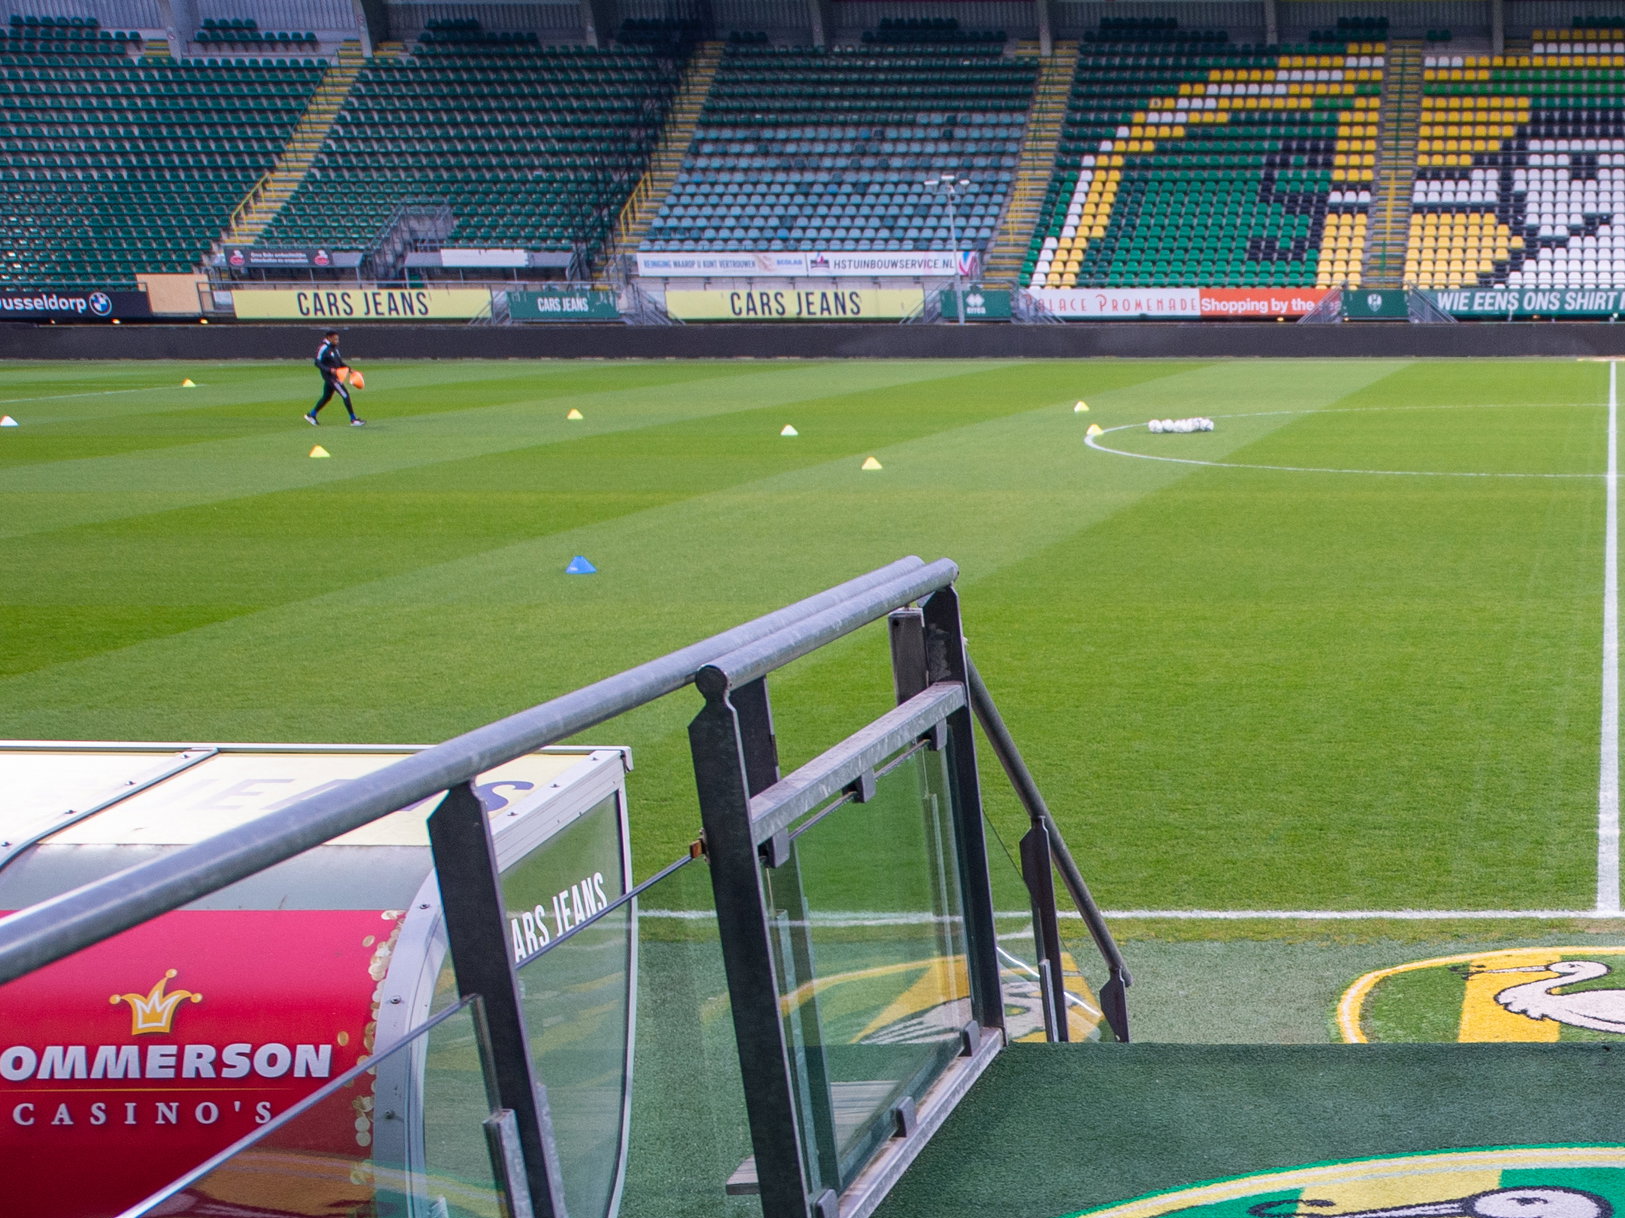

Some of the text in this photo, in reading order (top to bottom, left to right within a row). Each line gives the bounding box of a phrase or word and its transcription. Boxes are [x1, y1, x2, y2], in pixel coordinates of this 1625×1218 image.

[0, 293, 87, 314] usseldorp
[297, 292, 429, 316] CARS JEANS
[537, 297, 589, 313] CARS JEANS
[730, 291, 862, 316] CARS JEANS
[1201, 298, 1268, 313] Shopping
[1271, 298, 1291, 313] by
[1292, 298, 1315, 311] the
[1437, 292, 1471, 310] WIE
[1473, 292, 1519, 310] EENS
[1522, 292, 1560, 310] ONS
[1564, 291, 1618, 310] SHIRT
[511, 872, 608, 963] ARS JEANS
[0, 1043, 332, 1081] OMMERSON
[12, 1101, 273, 1126] CASINO'S
